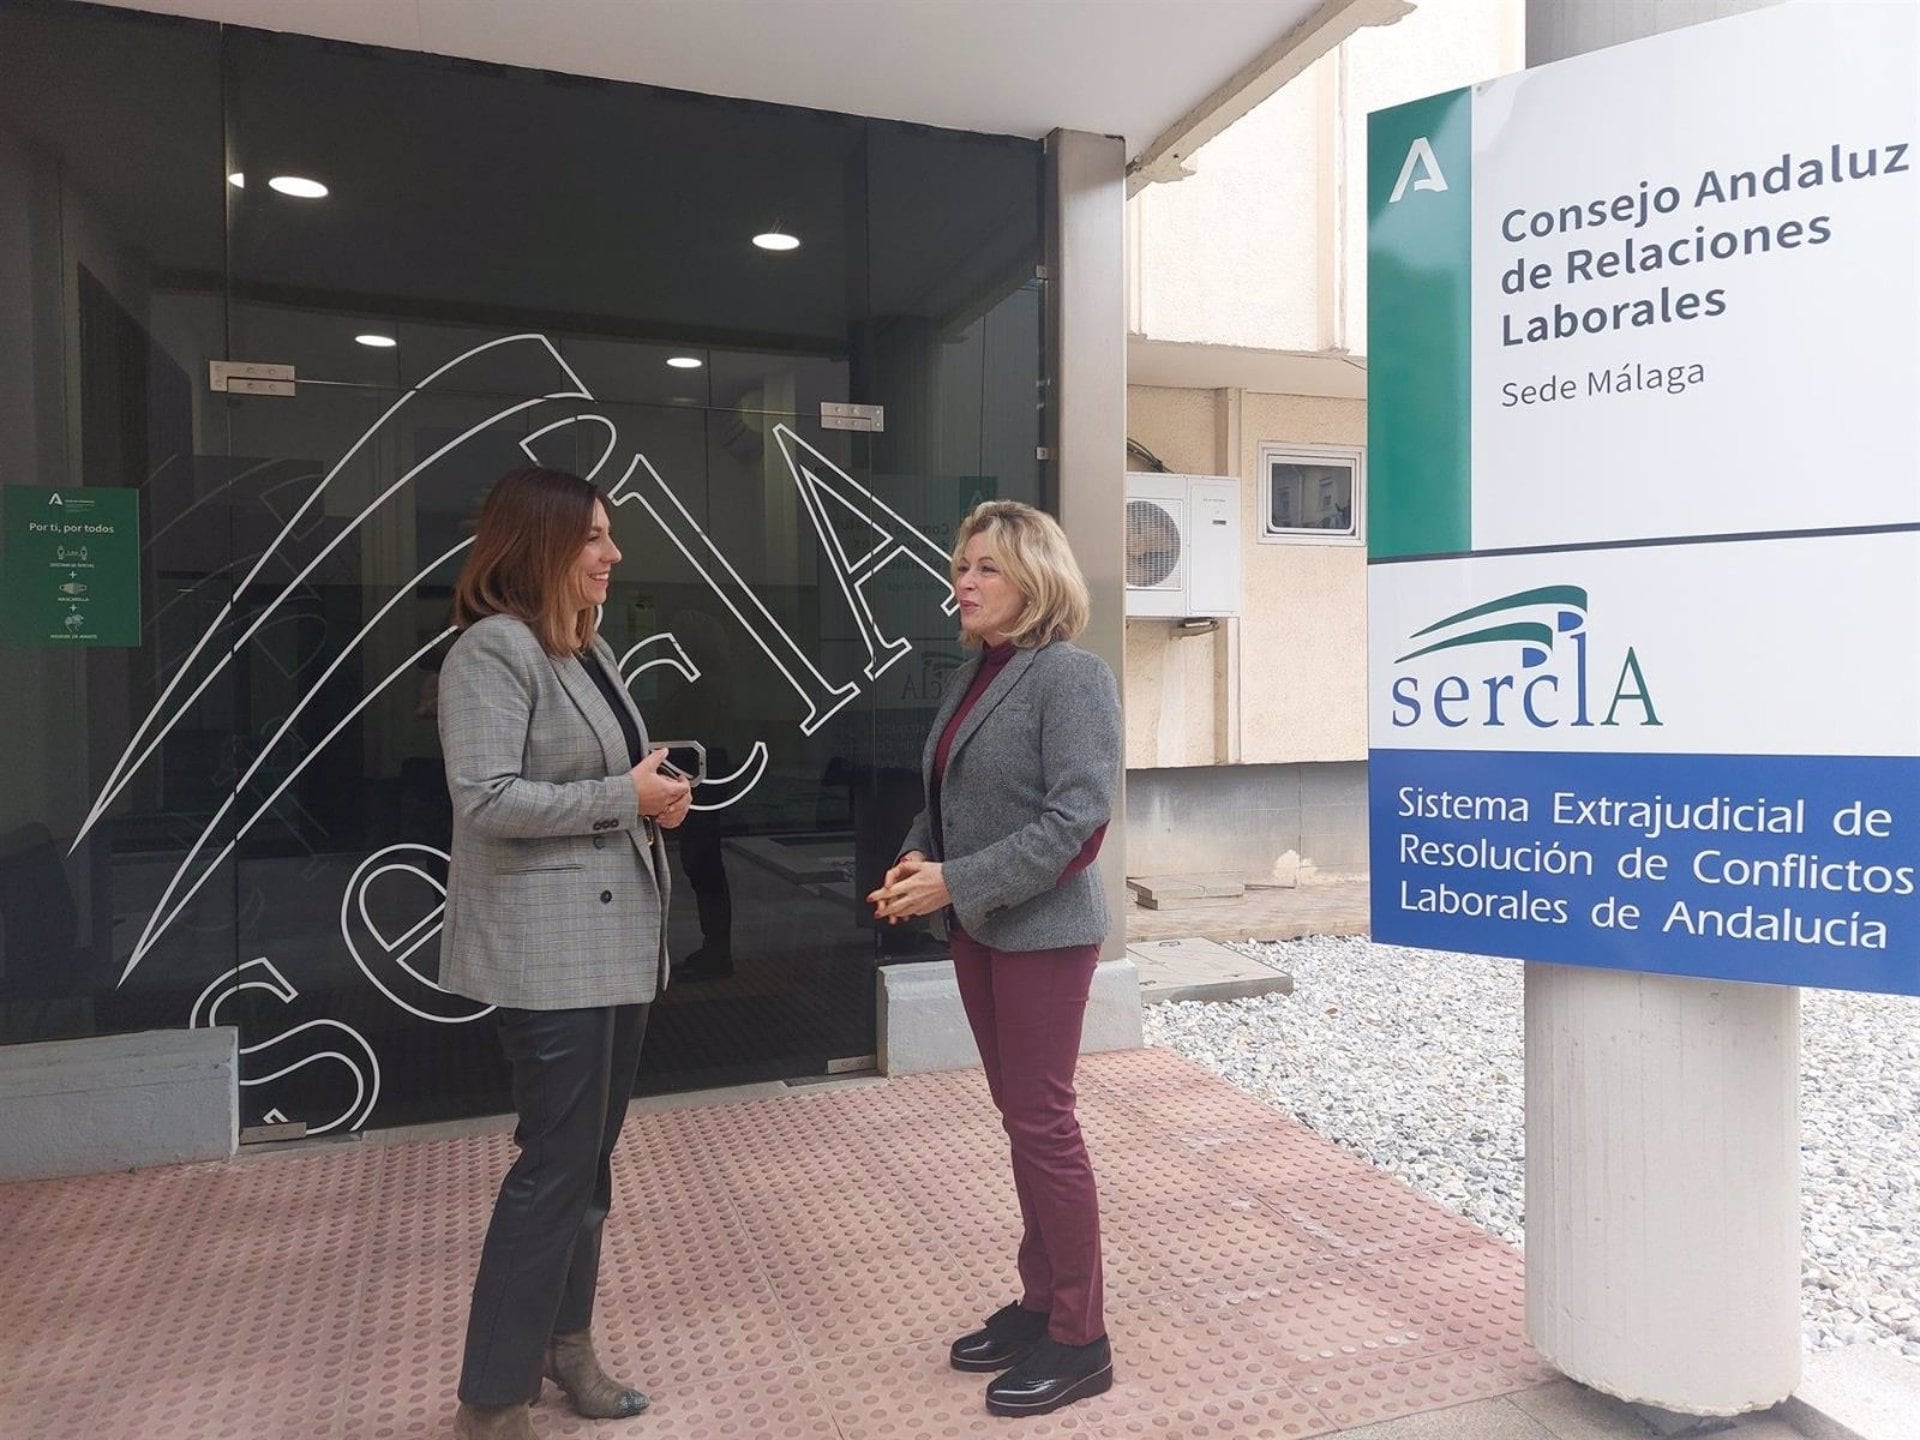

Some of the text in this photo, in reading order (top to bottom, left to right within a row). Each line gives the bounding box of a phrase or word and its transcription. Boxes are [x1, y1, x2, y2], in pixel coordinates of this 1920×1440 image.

[1501, 143, 1909, 243] Consejo Andaluz
[1501, 215, 1831, 295] de Relaciones
[1502, 286, 1726, 347] Laborales
[1501, 362, 1705, 408] Sede Málaga
[29, 522, 48, 532] Por
[63, 524, 82, 535] por
[84, 524, 114, 534] todos
[1391, 630, 1664, 728] serclA
[1398, 786, 1892, 839] Sistema Extrajudicial de
[1400, 833, 1915, 896] Resolución de Conflictos
[1401, 880, 1888, 949] Laborales de Andalucía
